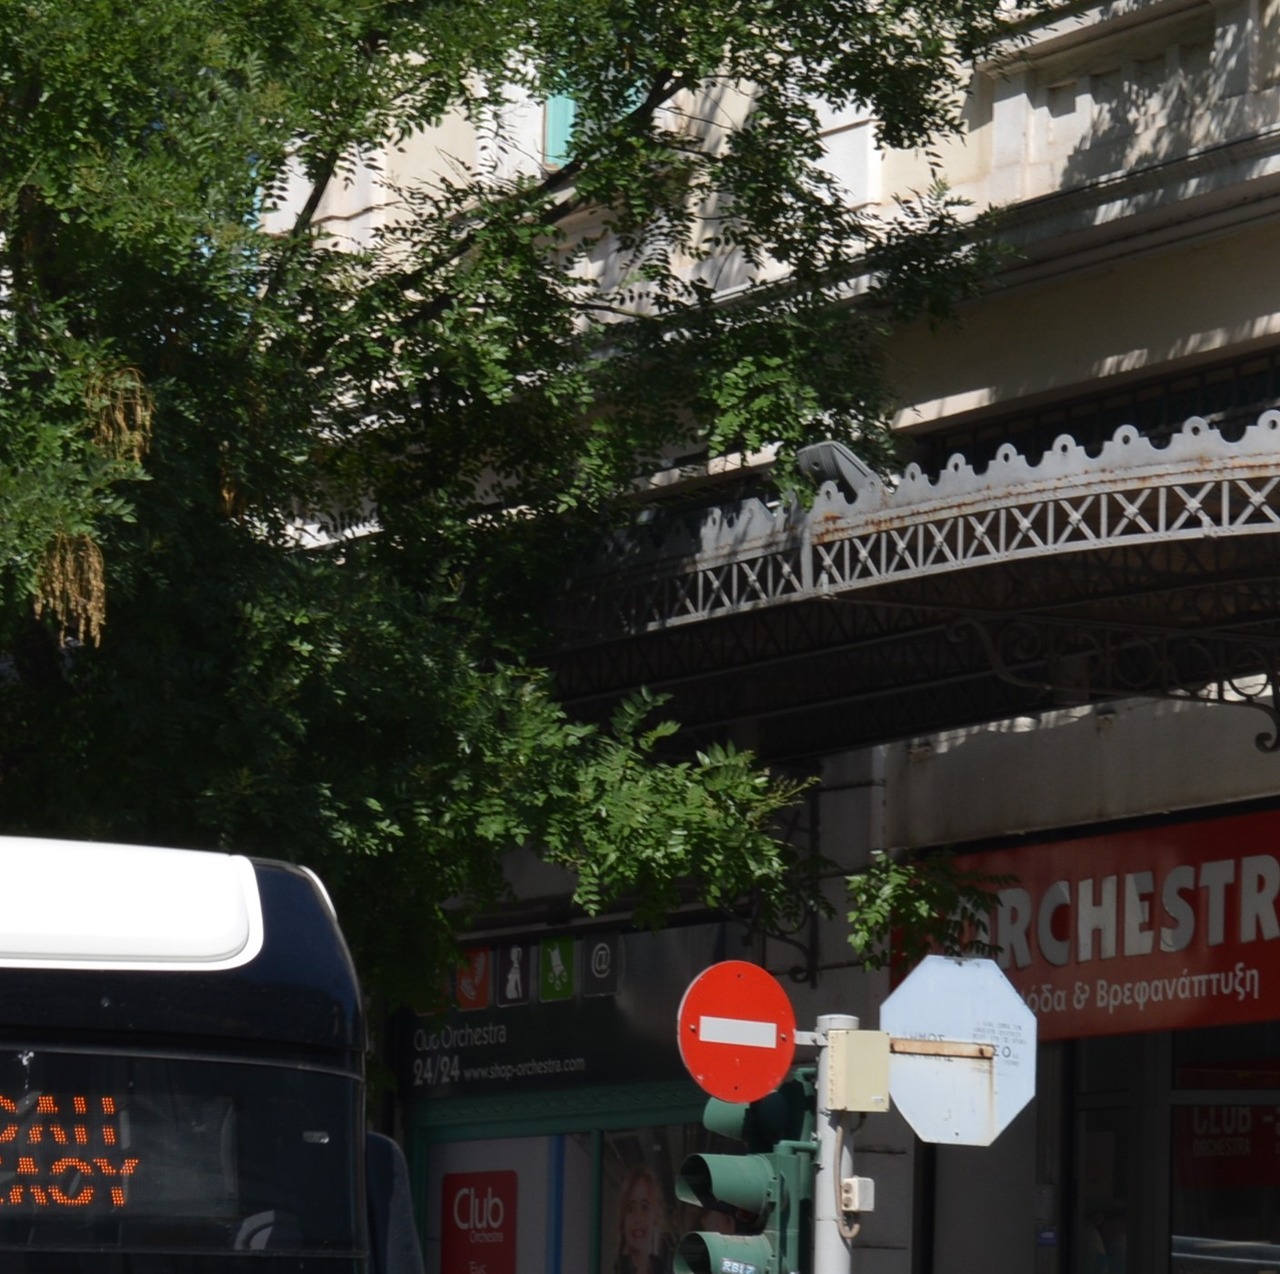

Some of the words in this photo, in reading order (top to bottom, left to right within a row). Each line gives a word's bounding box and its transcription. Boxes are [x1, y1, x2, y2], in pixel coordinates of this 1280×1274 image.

[1023, 984, 1067, 1014] όδα
[1072, 981, 1090, 1010] &
[1096, 962, 1260, 1014] Βρεφανάπτυξη
[440, 1021, 508, 1049] Orchestra
[413, 1055, 461, 1086] 24/24
[463, 1057, 586, 1080] www.shop-orchestra.com
[1192, 1106, 1252, 1136] CLUB
[453, 1186, 505, 1230] Club
